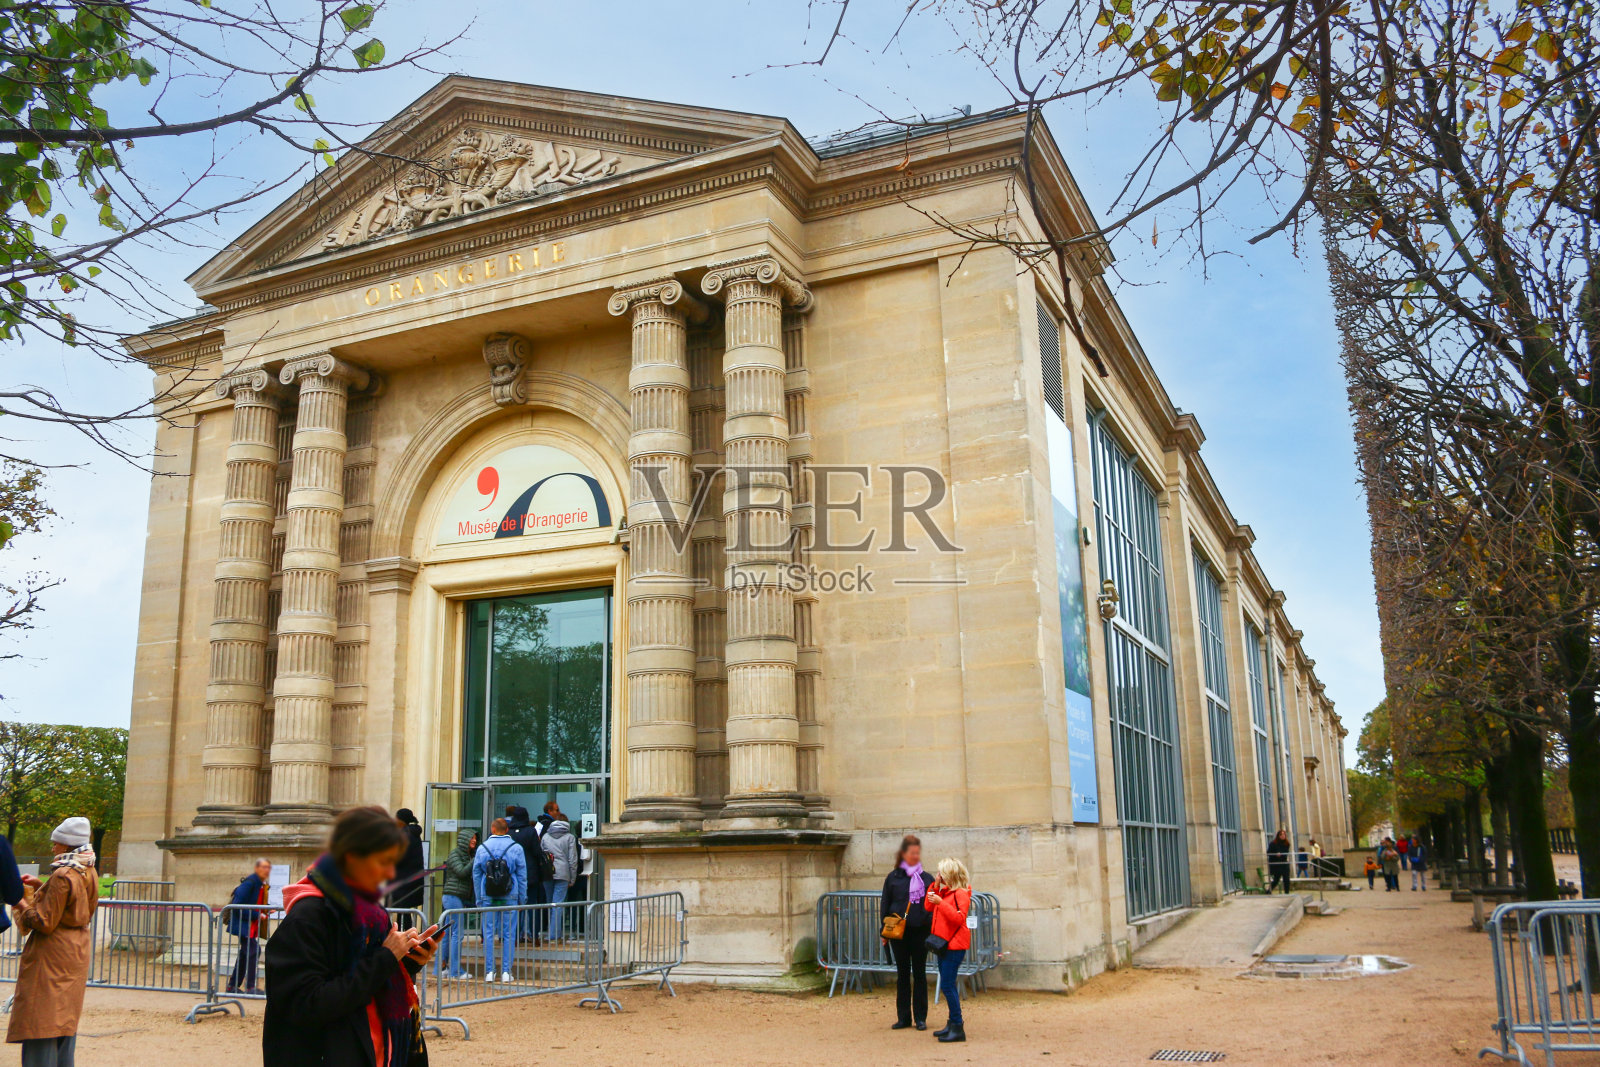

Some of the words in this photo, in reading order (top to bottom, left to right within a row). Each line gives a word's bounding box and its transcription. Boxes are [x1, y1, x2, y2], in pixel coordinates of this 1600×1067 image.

[364, 241, 566, 307] ORANGERIE
[458, 518, 498, 536] Musée
[501, 516, 517, 532] de
